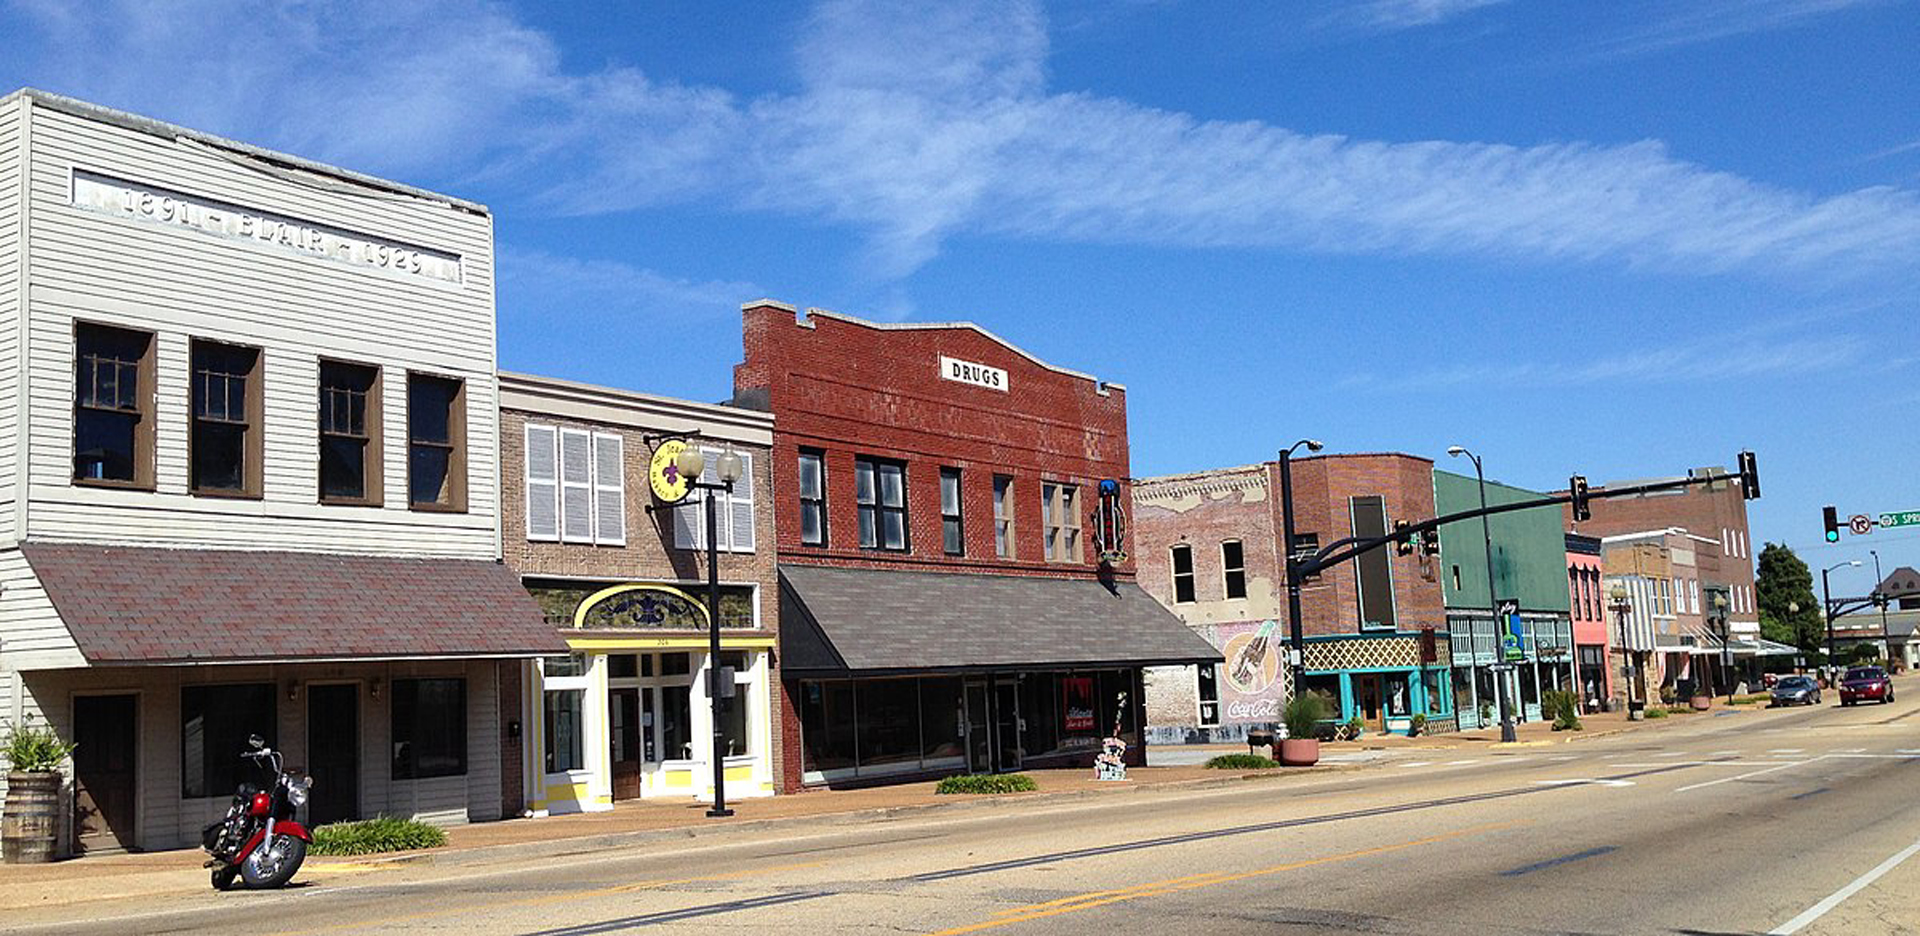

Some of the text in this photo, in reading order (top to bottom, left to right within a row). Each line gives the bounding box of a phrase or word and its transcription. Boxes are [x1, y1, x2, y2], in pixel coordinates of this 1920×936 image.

[124, 188, 190, 225] 1891
[240, 213, 326, 253] BLAIR
[364, 242, 423, 275] 1929
[952, 362, 1000, 387] DRUGS
[1892, 514, 1898, 525] S
